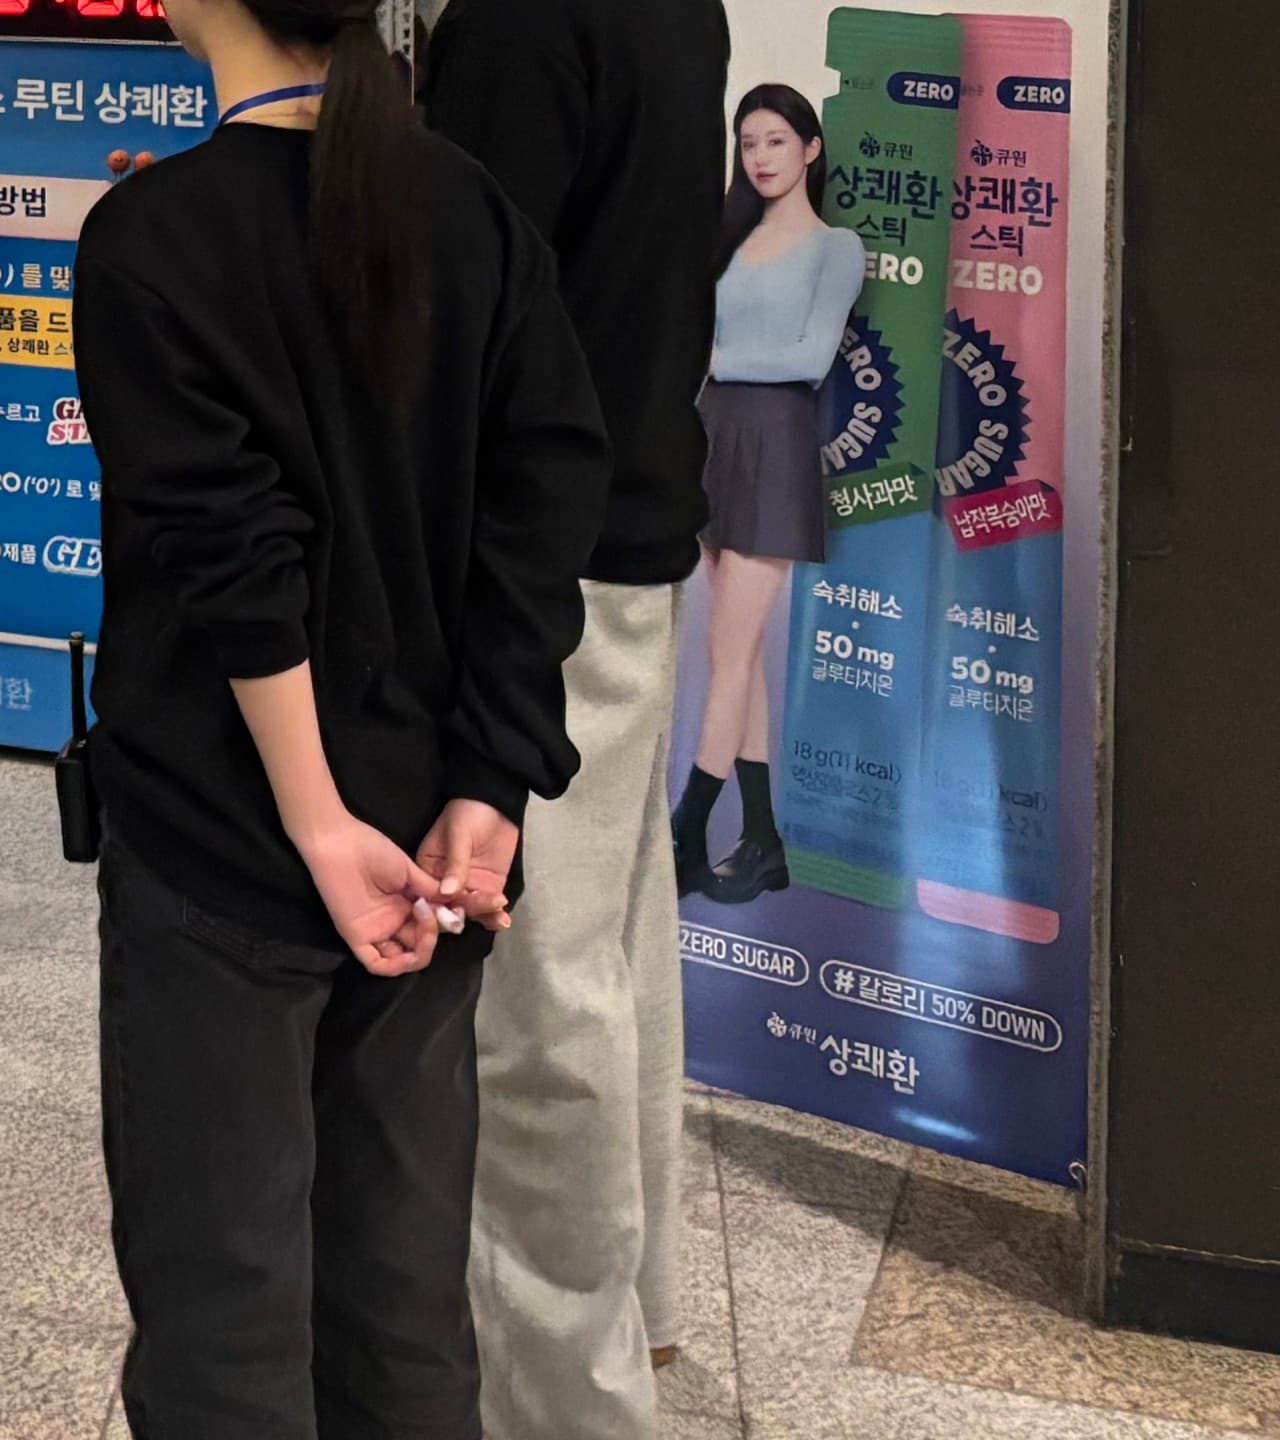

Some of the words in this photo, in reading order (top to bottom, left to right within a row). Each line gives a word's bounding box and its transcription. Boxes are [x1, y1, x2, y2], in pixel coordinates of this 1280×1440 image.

[13, 78, 85, 121] 루틴
[94, 82, 208, 128] 상쾌환
[903, 80, 955, 101] ZERO
[1013, 85, 1066, 105] ZERO
[827, 164, 943, 220] 상쾌환
[951, 175, 1059, 227] 상쾌환
[856, 214, 908, 247] 스틱
[970, 224, 1025, 257] 스틱
[864, 251, 924, 286] ERO
[953, 259, 1043, 295] ZERO
[839, 324, 882, 391] ERO
[942, 326, 1007, 407] ZERO
[829, 474, 918, 517] 청사과맛
[812, 580, 903, 620] 숙취해소
[946, 604, 1040, 642] 숙취해소
[680, 930, 727, 960] ZERO
[731, 942, 796, 978] SUGAR
[932, 992, 976, 1026] 50%
[981, 1006, 1046, 1044] DOWN
[820, 1034, 920, 1095] 상쾌환
